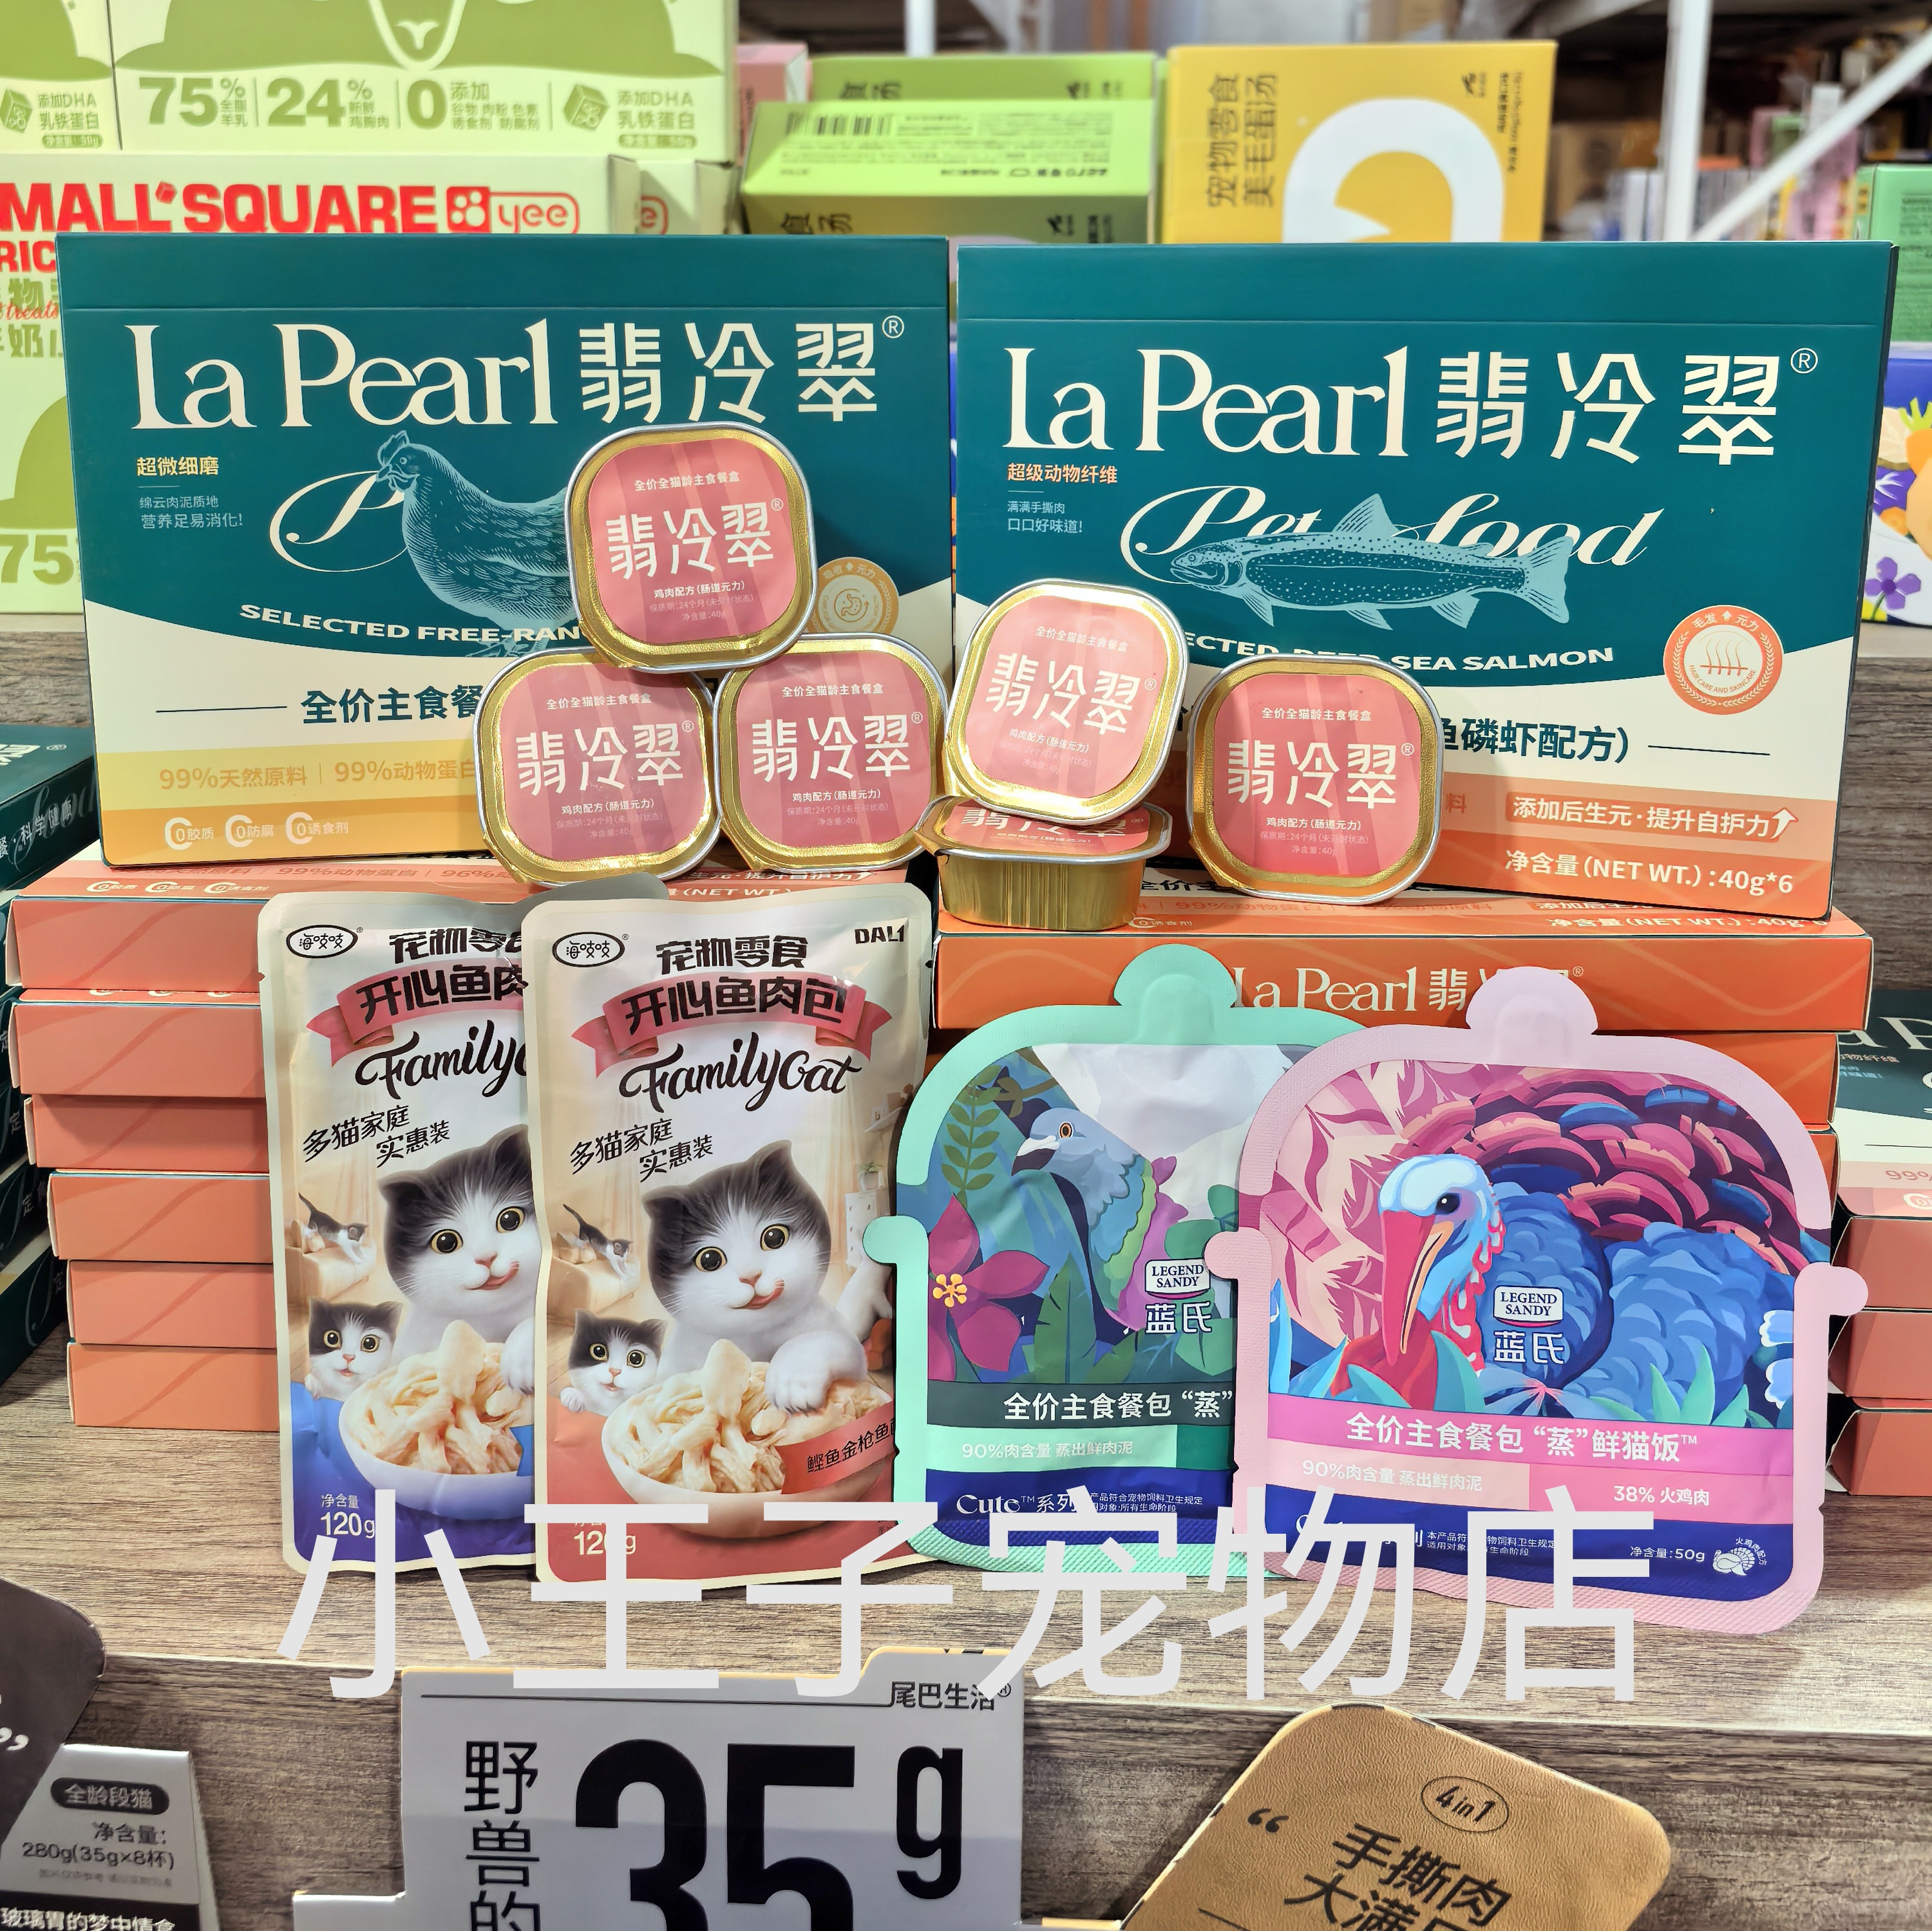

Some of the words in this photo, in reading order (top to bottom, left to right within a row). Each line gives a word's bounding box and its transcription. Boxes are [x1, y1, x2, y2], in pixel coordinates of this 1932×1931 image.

[124, 325, 258, 429] La
[272, 317, 559, 428] Pearl
[1002, 347, 1115, 450] La
[1135, 345, 1409, 457] Pearl
[136, 455, 220, 477] 超微细磨
[1007, 462, 1118, 485] 超级动物纤维
[634, 471, 740, 492] 全价全猫龄主食餐盒
[139, 495, 220, 511] 绵云肉泥质地
[1007, 499, 1066, 514] 满满手撕肉
[141, 513, 244, 531] 营养足易消化!
[1007, 517, 1083, 534] 口口好味道!
[654, 579, 745, 599] 鸡肉配方(肠道元力)
[239, 603, 410, 640] SELECTED
[1034, 626, 1128, 652] 全价全猫龄主食餐盒
[1391, 655, 1455, 671] SEA
[1462, 646, 1615, 672] SALMON
[782, 683, 884, 698] 全价全猫龄主食餐盒
[1697, 678, 1713, 691] CARE
[546, 693, 652, 710] 全价全猫龄主食餐盒
[1262, 707, 1372, 722] 全价全猫龄主食餐盒
[1009, 728, 1090, 753] 鸡肉配方(肠道元力)
[159, 765, 308, 791] 99%天然原料
[562, 798, 655, 815] 鸡肉配方(肠道元力)
[792, 788, 882, 802] 鸡肉配方(肠道元力)
[1266, 816, 1361, 831] 鸡肉配方(肠道元力)
[389, 927, 521, 963] 宠物零
[656, 935, 809, 975] 宠物零食
[1296, 967, 1417, 1012] Pearl
[621, 975, 846, 1035] 开心鱼肉包
[303, 1105, 410, 1163] 多猫家庭
[375, 1120, 450, 1168] 实惠装
[571, 1118, 673, 1175] 多猫家庭
[639, 1135, 714, 1183] 实惠装
[1151, 1265, 1204, 1277] LEGEND
[1157, 1276, 1200, 1288] SANDY
[1500, 1291, 1558, 1305] LEGEND
[1145, 1301, 1212, 1334] 蓝氏
[1505, 1303, 1553, 1317] SANDY
[1493, 1330, 1565, 1364] 蓝氏
[961, 1443, 1051, 1460] 90%肉含量
[1055, 1440, 1133, 1458] 蒸出鲜肉泥
[1302, 1459, 1396, 1485] 90%肉含量
[1398, 1469, 1483, 1492] 蒸出鲜肉泥
[321, 1493, 359, 1509] 净含量
[1613, 1485, 1655, 1504] 38%
[1660, 1487, 1710, 1507] 火鸡肉
[320, 1512, 375, 1538] 120g
[574, 1530, 636, 1555] 12g
[1630, 1545, 1705, 1563] 净含量:50g
[1331, 1823, 1513, 1928] 手撕肉
[1284, 1873, 1468, 1931] 大满
